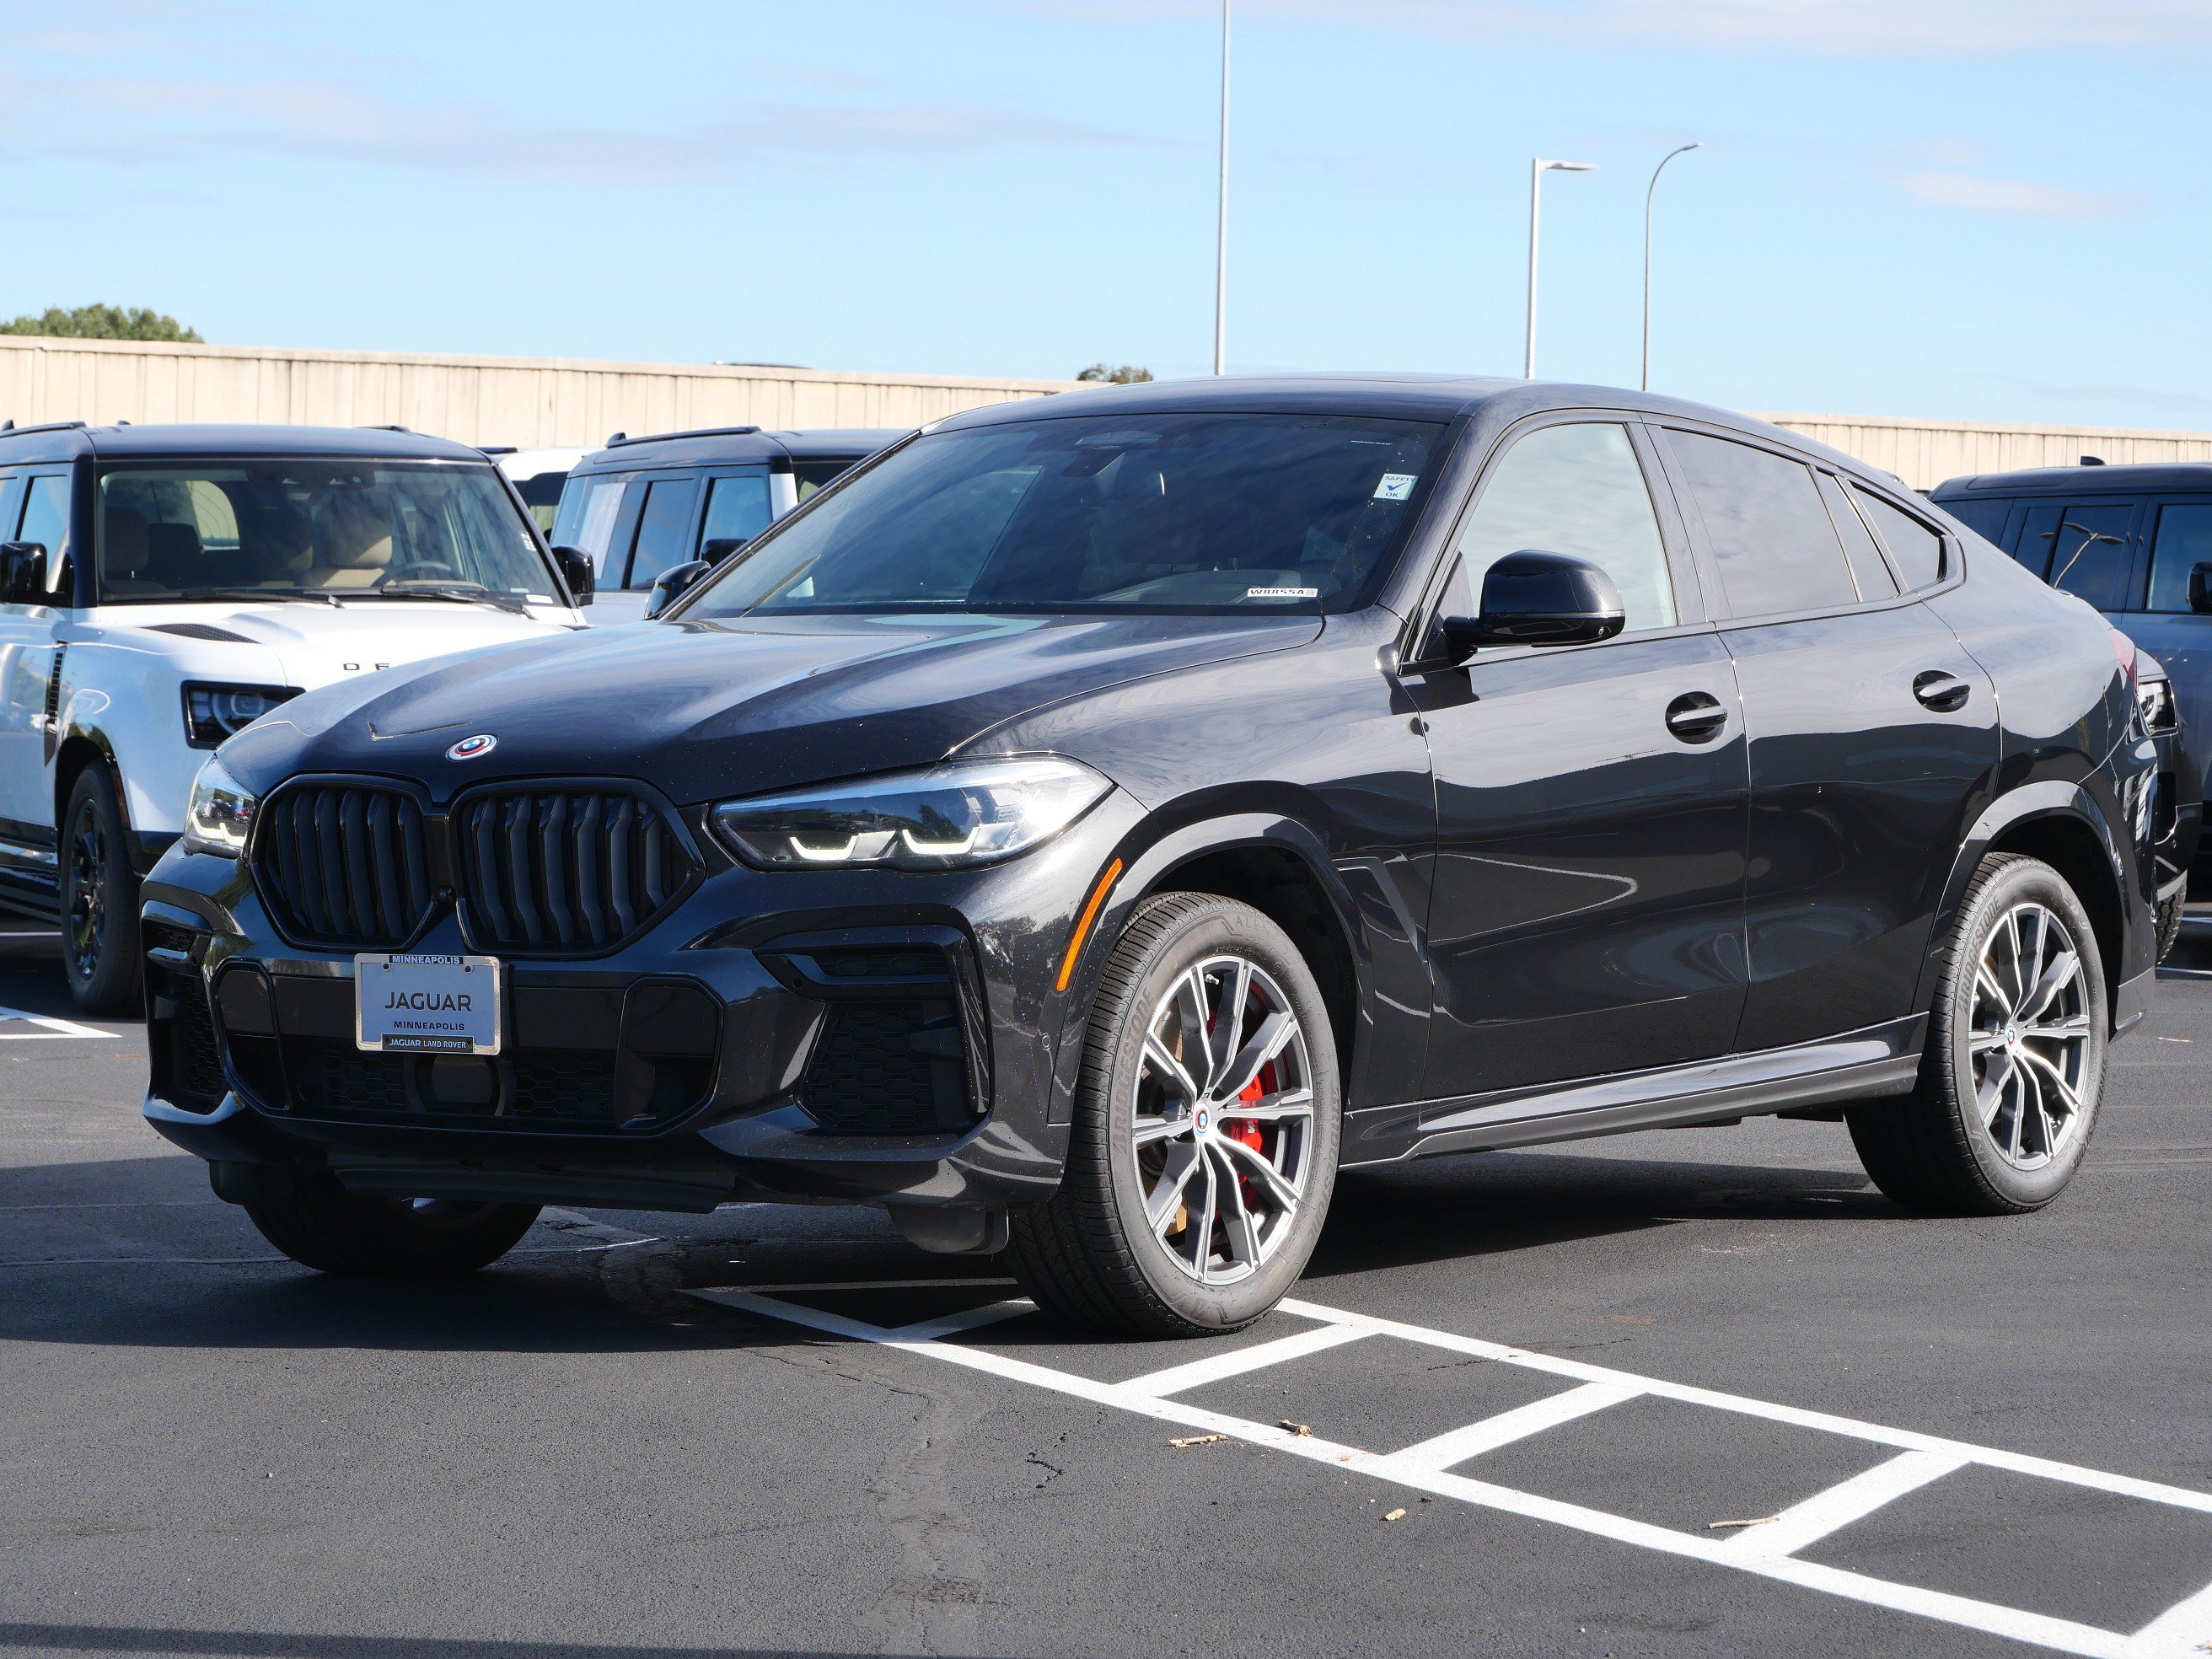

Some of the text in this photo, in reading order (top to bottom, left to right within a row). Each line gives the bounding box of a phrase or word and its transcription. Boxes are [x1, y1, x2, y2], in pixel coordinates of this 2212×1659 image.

[392, 955, 460, 964] MINNEAPOLIS
[384, 991, 473, 1012] JAGUAR
[394, 1021, 465, 1031] MINNEAPOLIS
[389, 1039, 421, 1048] JAGUAR
